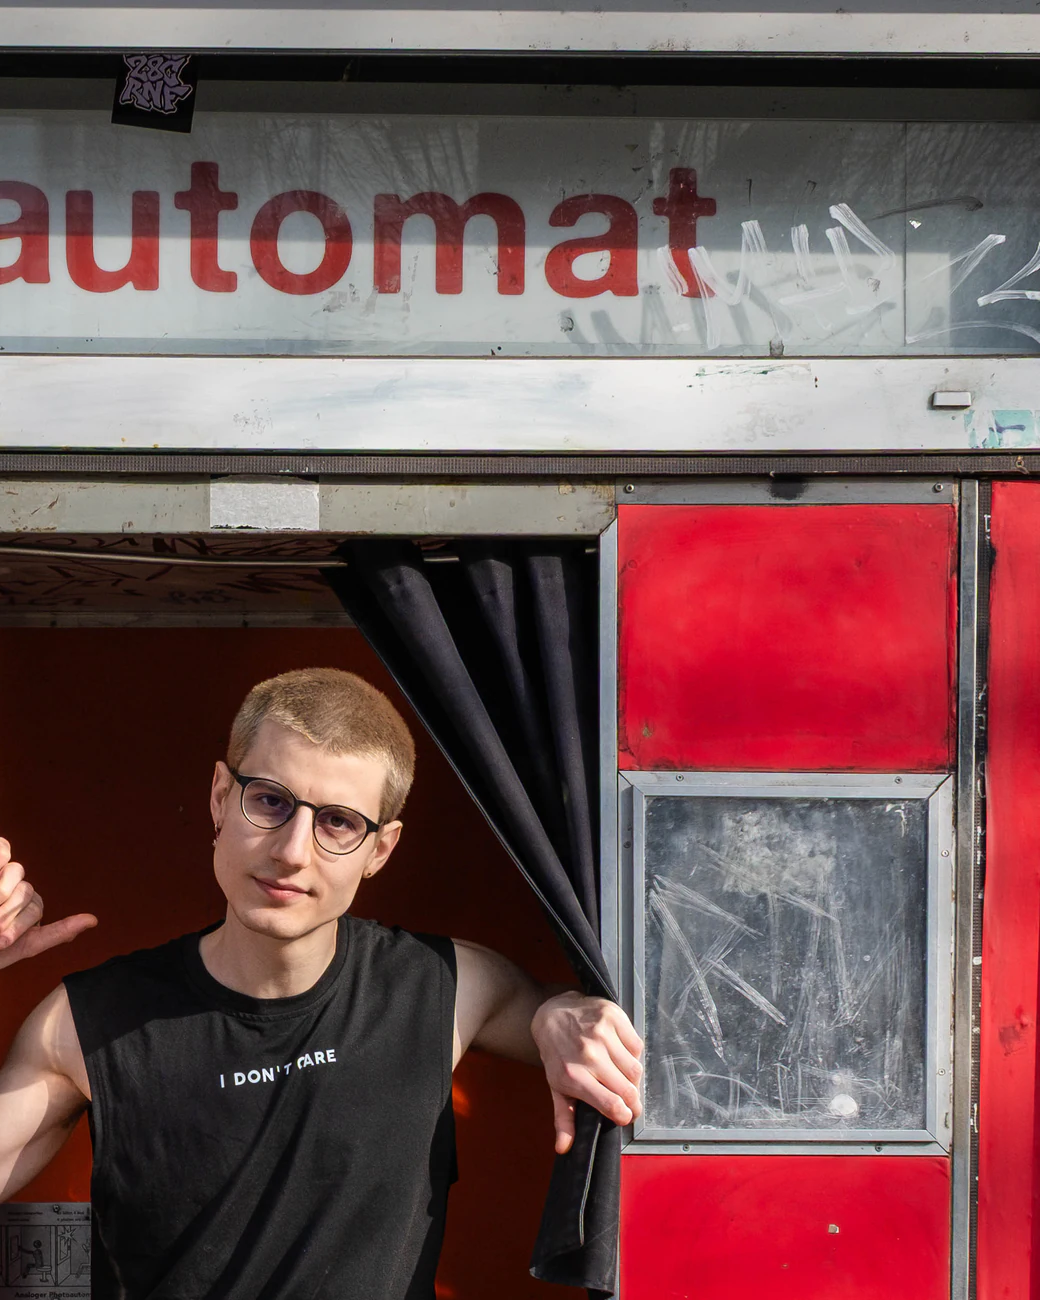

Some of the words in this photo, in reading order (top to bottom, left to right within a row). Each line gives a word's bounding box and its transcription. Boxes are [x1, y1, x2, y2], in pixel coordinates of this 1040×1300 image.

[220, 1074, 225, 1088] I
[234, 1062, 292, 1086] DON'T
[297, 1049, 337, 1069] CARE
